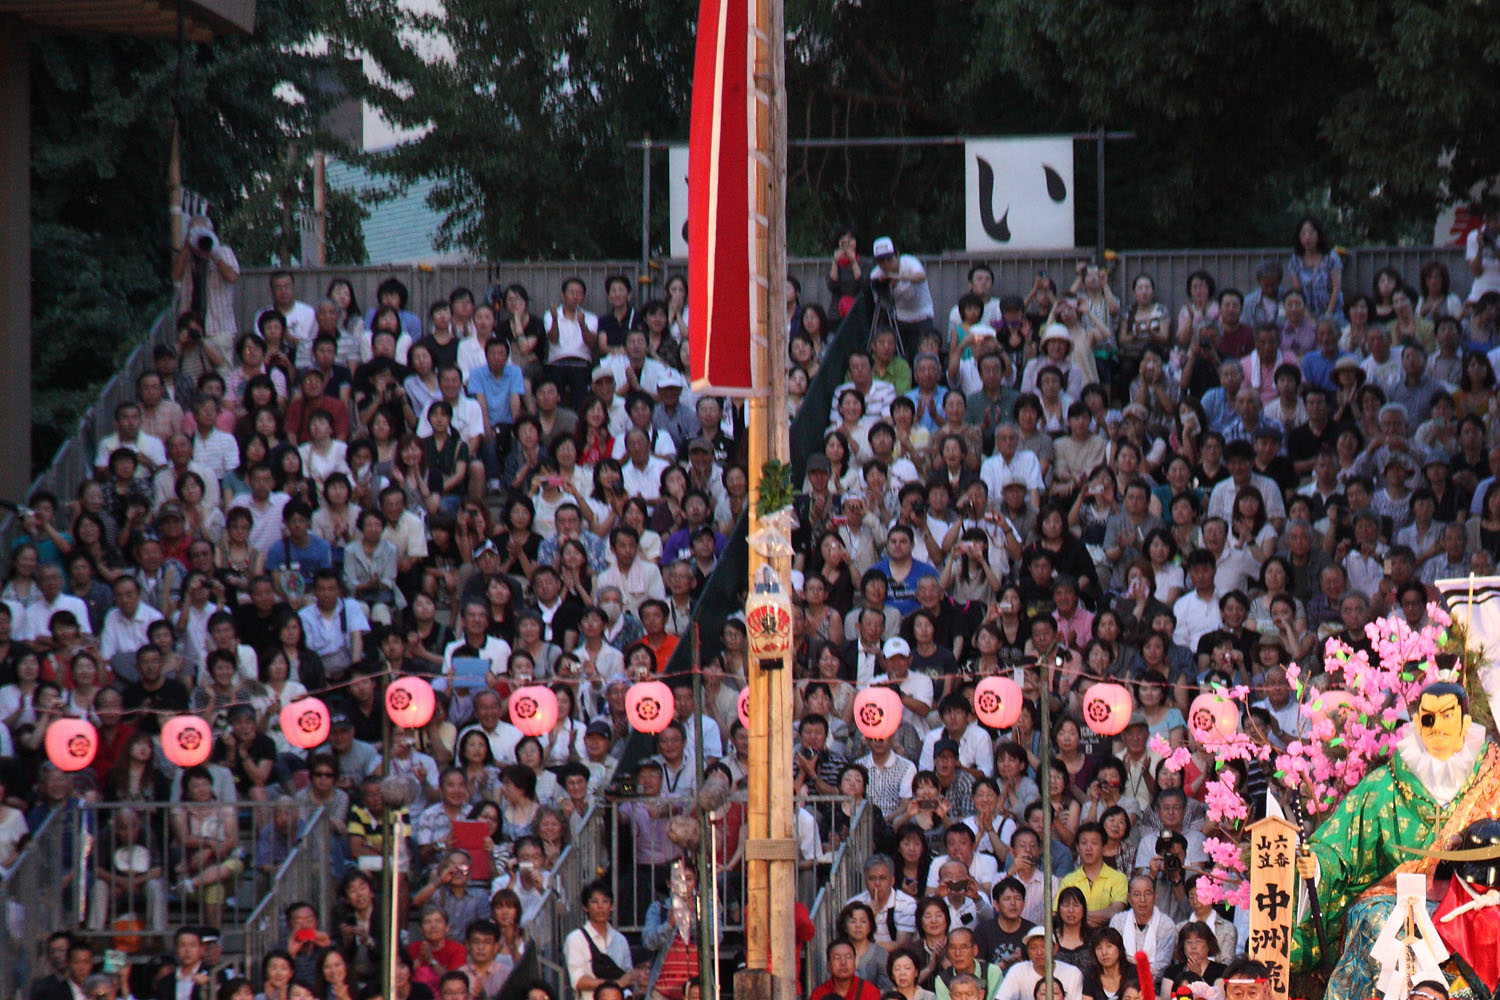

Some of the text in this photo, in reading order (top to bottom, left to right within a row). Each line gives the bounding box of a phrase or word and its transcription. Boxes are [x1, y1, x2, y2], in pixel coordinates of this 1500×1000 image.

[976, 155, 1066, 243] い
[1257, 836, 1274, 869] 山笠
[1273, 834, 1290, 869] 六番
